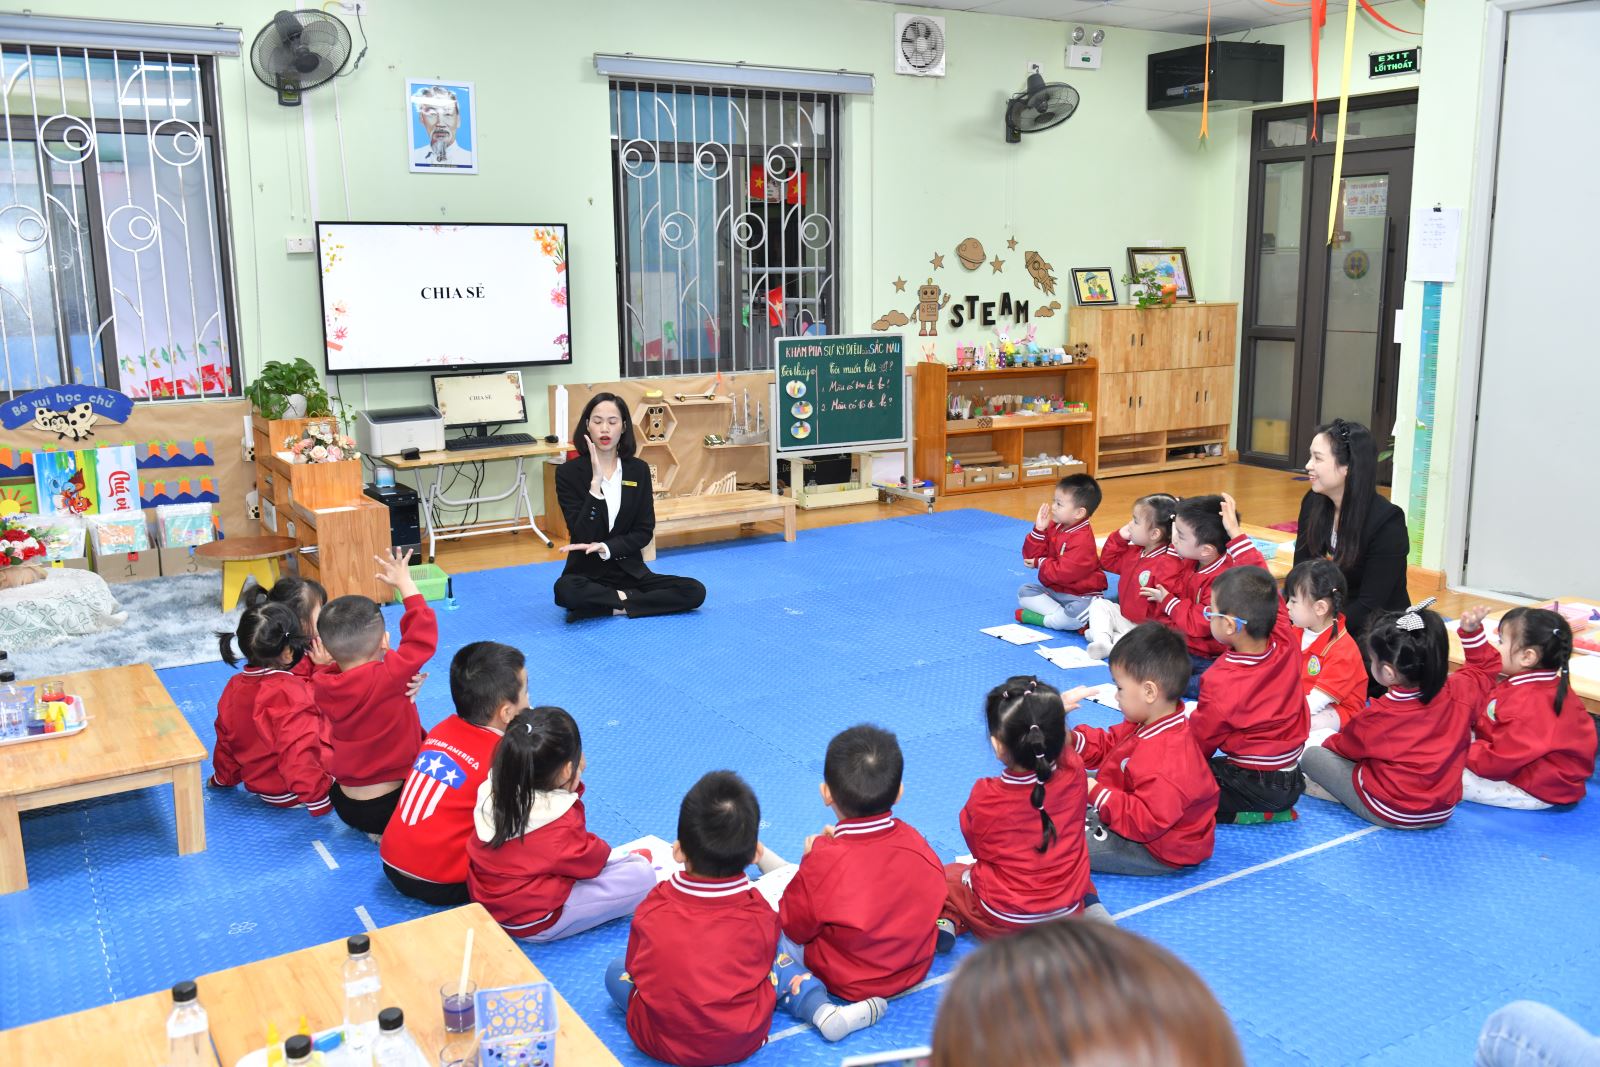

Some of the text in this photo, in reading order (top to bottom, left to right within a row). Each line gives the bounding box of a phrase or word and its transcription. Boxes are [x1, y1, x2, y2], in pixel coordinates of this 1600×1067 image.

[1379, 52, 1409, 62] EXIT
[1375, 60, 1413, 72] LỐI THOÁT
[420, 286, 463, 300] CHIA
[950, 292, 1029, 328] STEAM
[11, 393, 116, 416] Bé vui học chữ
[108, 470, 131, 511] Chú vị
[125, 564, 137, 578] 1
[186, 556, 198, 573] 3
[424, 738, 480, 771] CAPTAIN AMERICA
